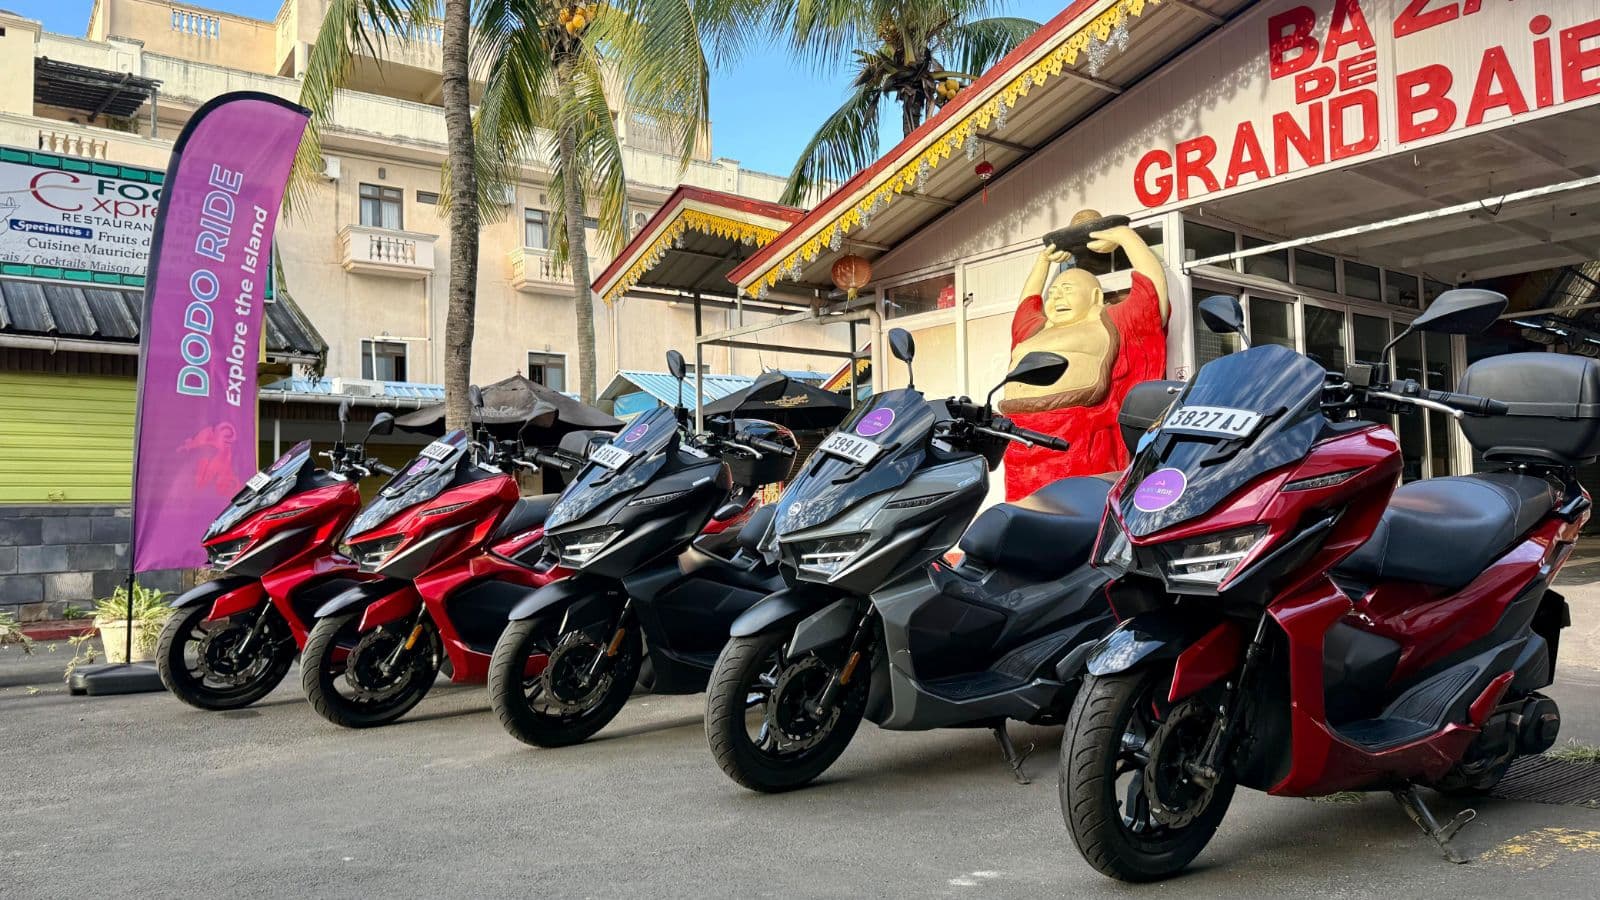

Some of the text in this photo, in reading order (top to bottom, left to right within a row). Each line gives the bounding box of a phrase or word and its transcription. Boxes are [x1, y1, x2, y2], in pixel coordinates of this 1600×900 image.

[1295, 50, 1377, 104] DE
[1134, 88, 1380, 208] GRAND
[27, 237, 80, 252] Cuisine
[98, 231, 138, 246] Fruits
[195, 163, 244, 262] RIDE
[33, 254, 87, 269] Cocktails
[89, 260, 131, 273] Maison
[176, 268, 220, 397] DODO
[226, 205, 268, 407] Explore the Island
